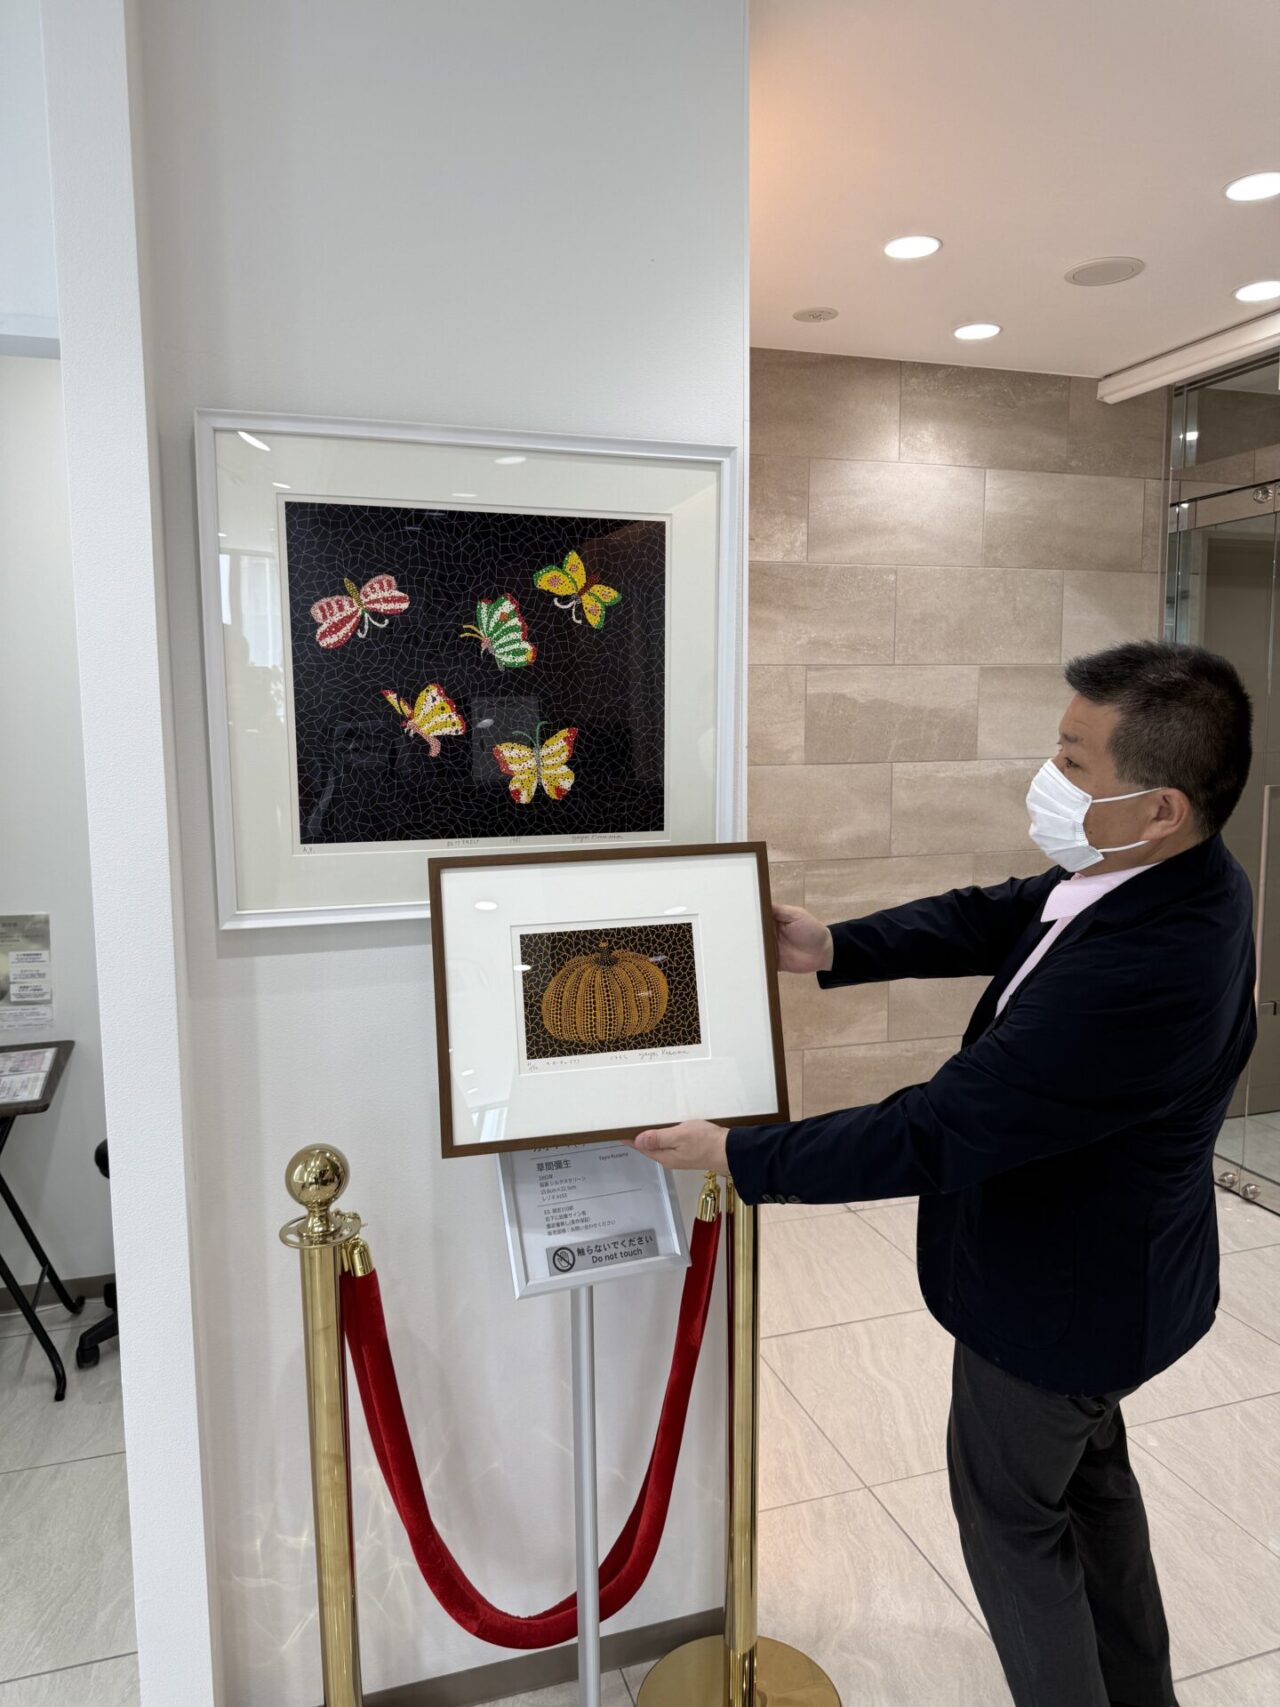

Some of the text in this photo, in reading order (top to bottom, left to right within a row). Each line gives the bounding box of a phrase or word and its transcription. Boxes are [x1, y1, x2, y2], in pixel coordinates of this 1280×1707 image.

[536, 1159, 572, 1172] 草間彌生
[576, 1235, 653, 1257] 触らないでください
[592, 1248, 643, 1263] Do not touch
